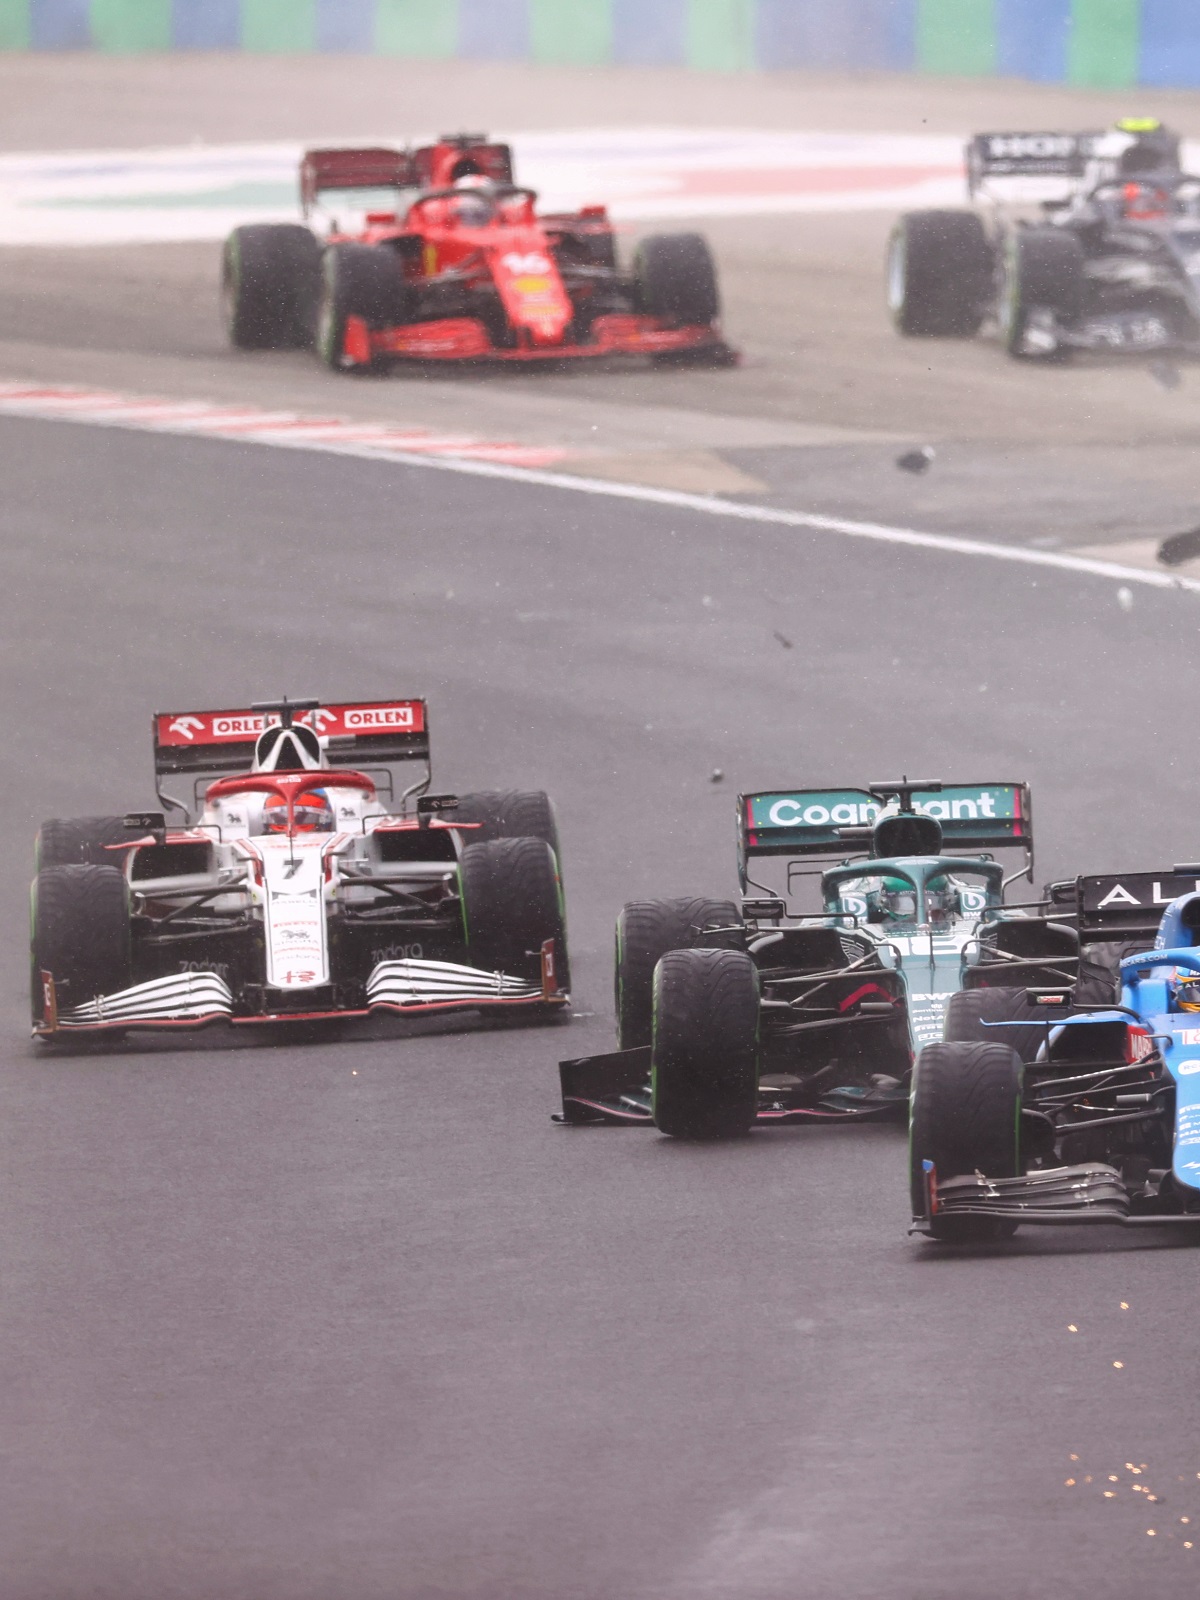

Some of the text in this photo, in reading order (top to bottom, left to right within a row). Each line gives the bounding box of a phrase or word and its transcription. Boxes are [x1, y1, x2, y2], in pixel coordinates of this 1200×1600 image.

[349, 709, 408, 726] ORLEN
[769, 792, 996, 826] Cognant
[283, 858, 304, 880] 7
